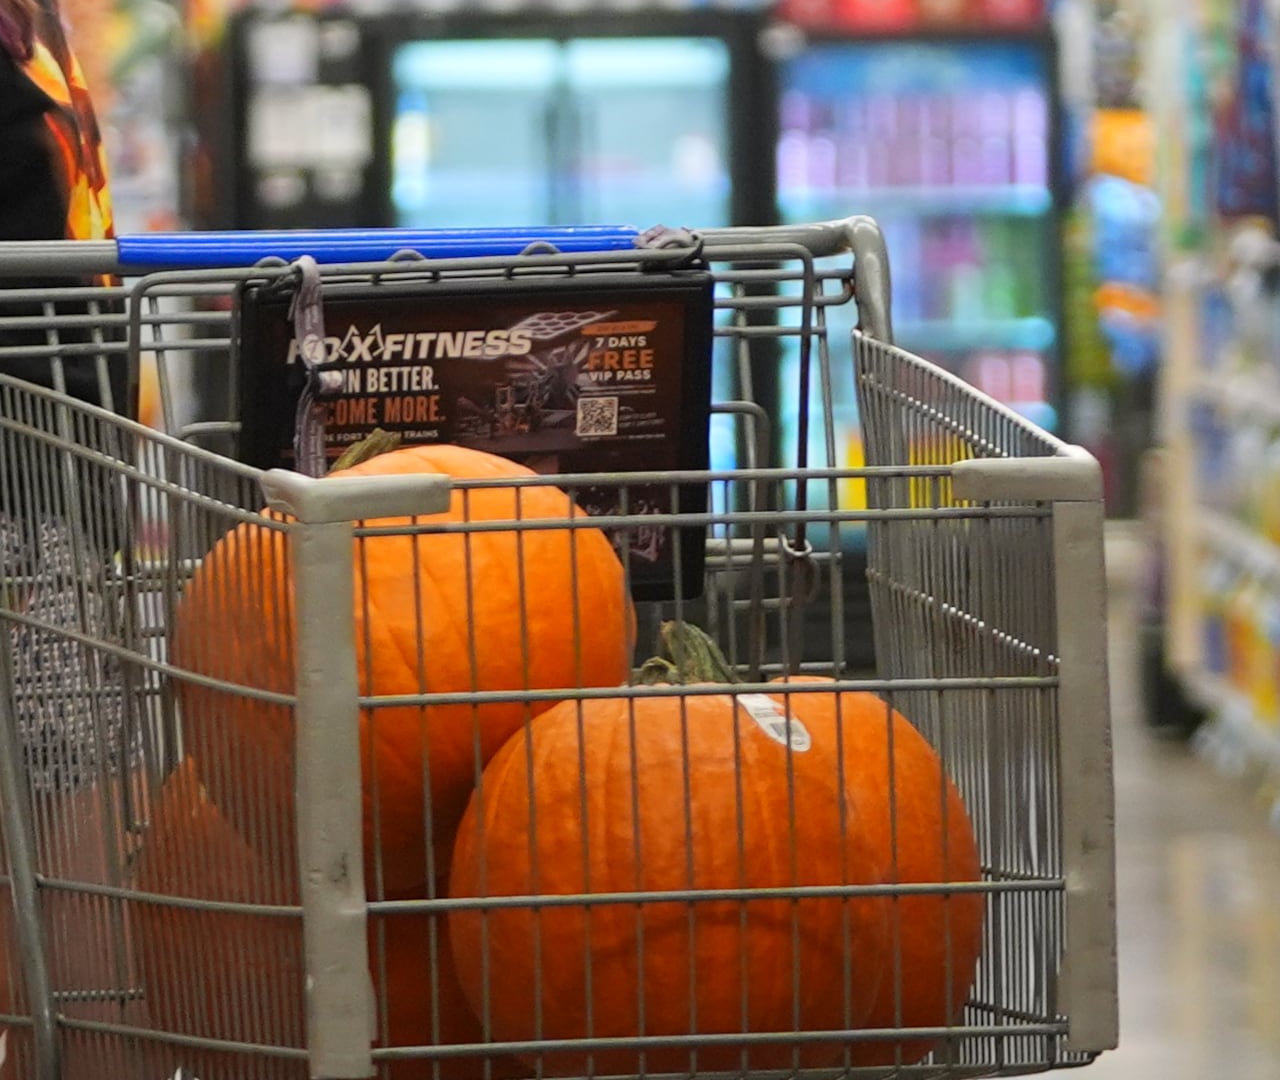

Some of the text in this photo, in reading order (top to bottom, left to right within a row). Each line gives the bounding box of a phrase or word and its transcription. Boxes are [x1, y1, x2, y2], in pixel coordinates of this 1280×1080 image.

[594, 335, 647, 348] 7 DAYS
[588, 348, 654, 371] FREE
[366, 366, 440, 393] BETTER.
[589, 369, 652, 381] VIP PASS
[324, 395, 447, 426] COME MORE.
[403, 429, 439, 440] TRAINS
